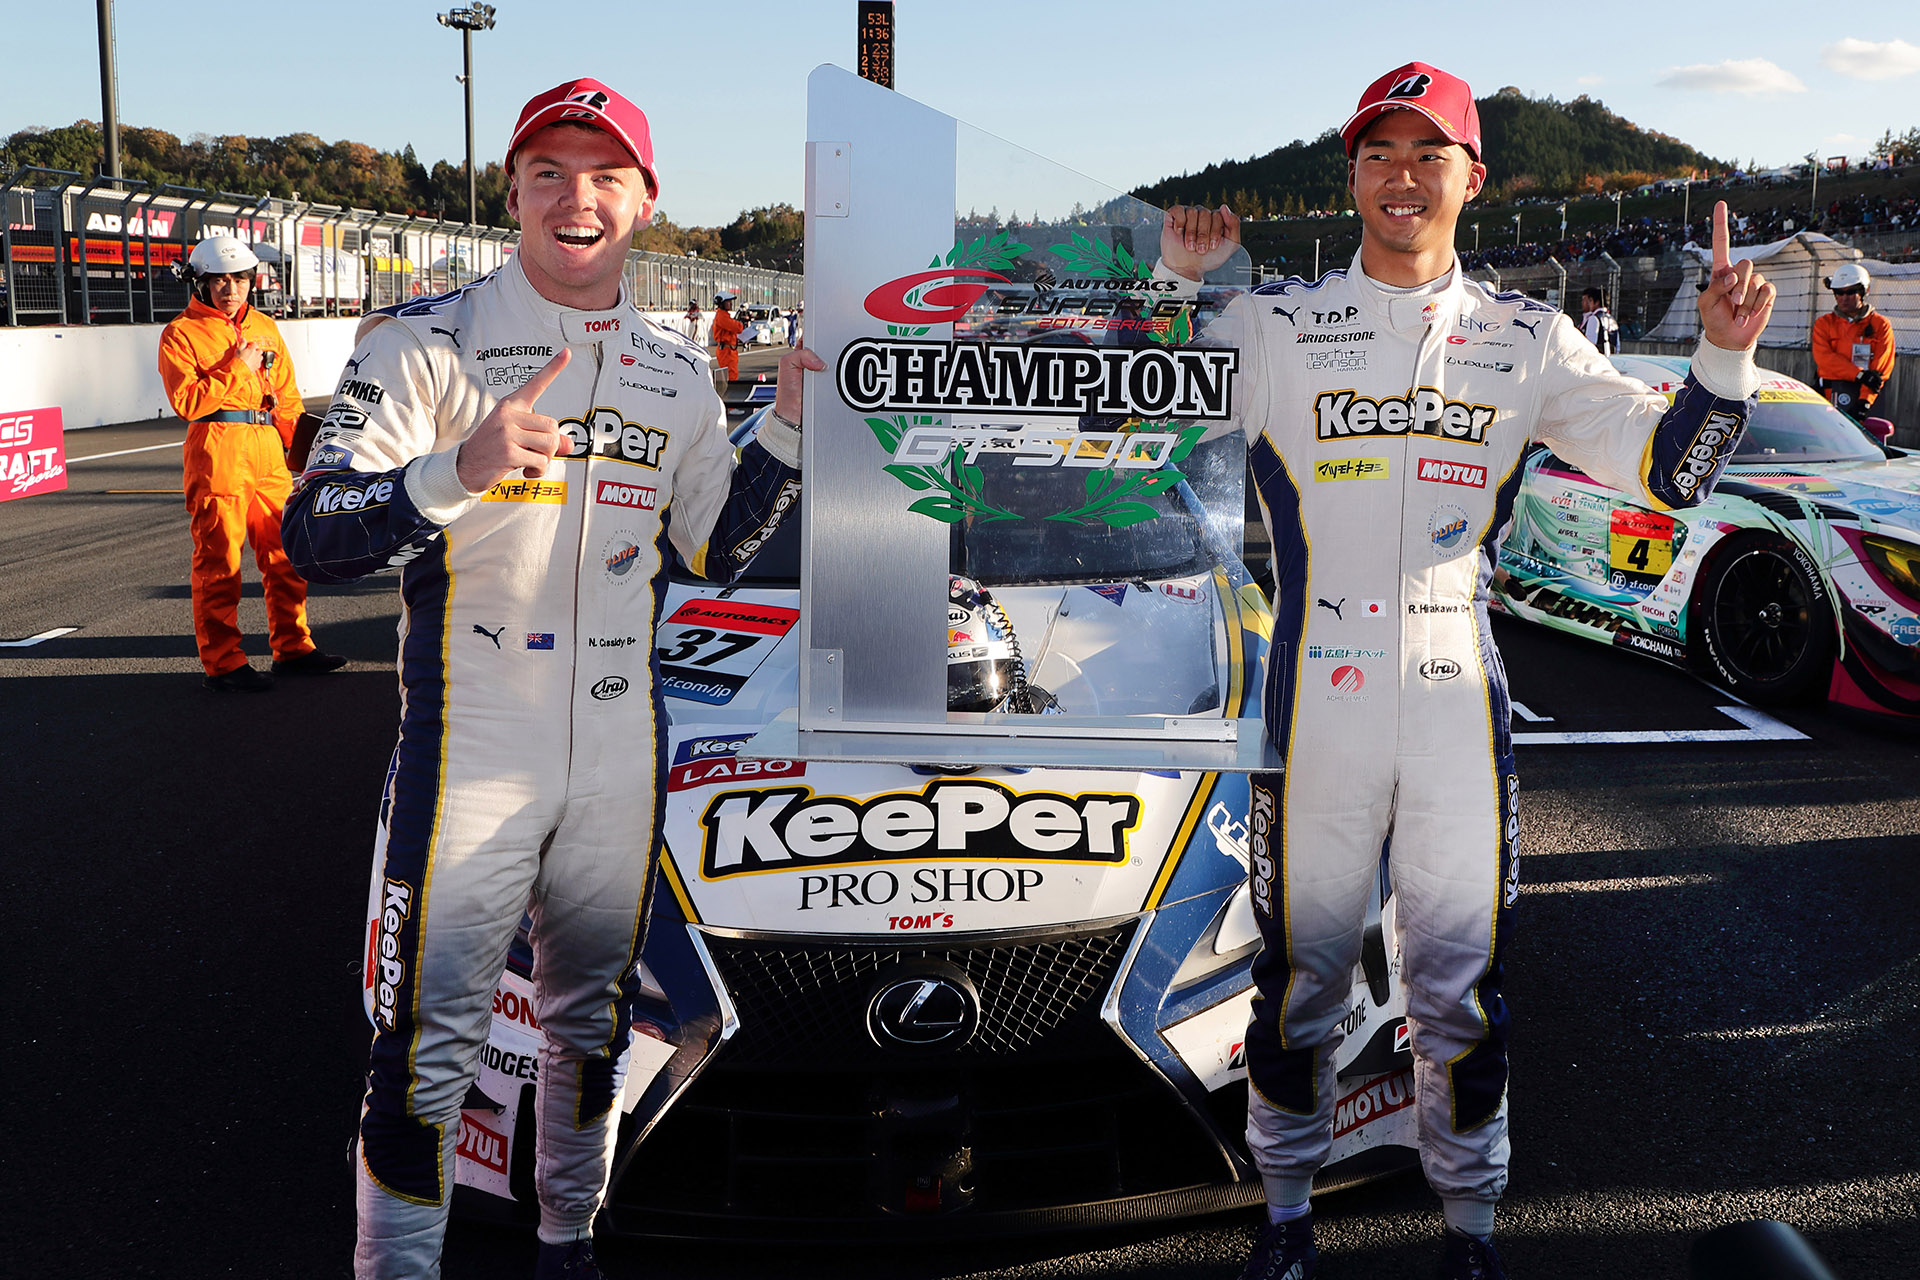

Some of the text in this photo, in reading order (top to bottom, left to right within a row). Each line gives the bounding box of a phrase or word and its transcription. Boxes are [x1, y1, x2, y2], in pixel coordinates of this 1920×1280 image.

[868, 13, 889, 25] 53L
[862, 27, 889, 40] 1:36
[872, 43, 889, 54] 23
[861, 55, 869, 66] 2
[86, 212, 170, 239] ADVAN
[1058, 278, 1179, 292] AUTOBACS
[997, 295, 1215, 318] SUPER GT
[584, 319, 621, 333] TOM'S
[1038, 317, 1170, 331] 2017 SERIES
[1459, 314, 1501, 333] ENG
[631, 332, 667, 359] ENG
[1297, 331, 1377, 344] BRIDGESTONE
[476, 346, 553, 361] BRIDGESTONE
[1457, 359, 1494, 369] LEXUS
[627, 381, 660, 394] LEXUS
[839, 340, 1238, 417] CHAMPION
[339, 379, 385, 405] ENKEI
[1317, 389, 1493, 441] KeePer
[1674, 413, 1738, 498] KeePer
[10, 464, 64, 493] Sports
[1421, 463, 1484, 485] MOTUL
[1627, 539, 1650, 571] 4
[1793, 547, 1823, 600] YOKOHAMA
[699, 610, 791, 627] AUTOBACS
[1642, 605, 1665, 618] RICOH
[657, 628, 763, 667] 37
[1630, 634, 1673, 657] YOKOHAMA
[1422, 660, 1456, 675] Arai
[682, 760, 793, 784] LABO
[712, 786, 1132, 869] KeePer
[1254, 788, 1274, 916] KeePer
[798, 867, 1045, 911] PRO SHOP
[888, 912, 955, 930] TOM'S
[379, 882, 410, 1028] KeePer
